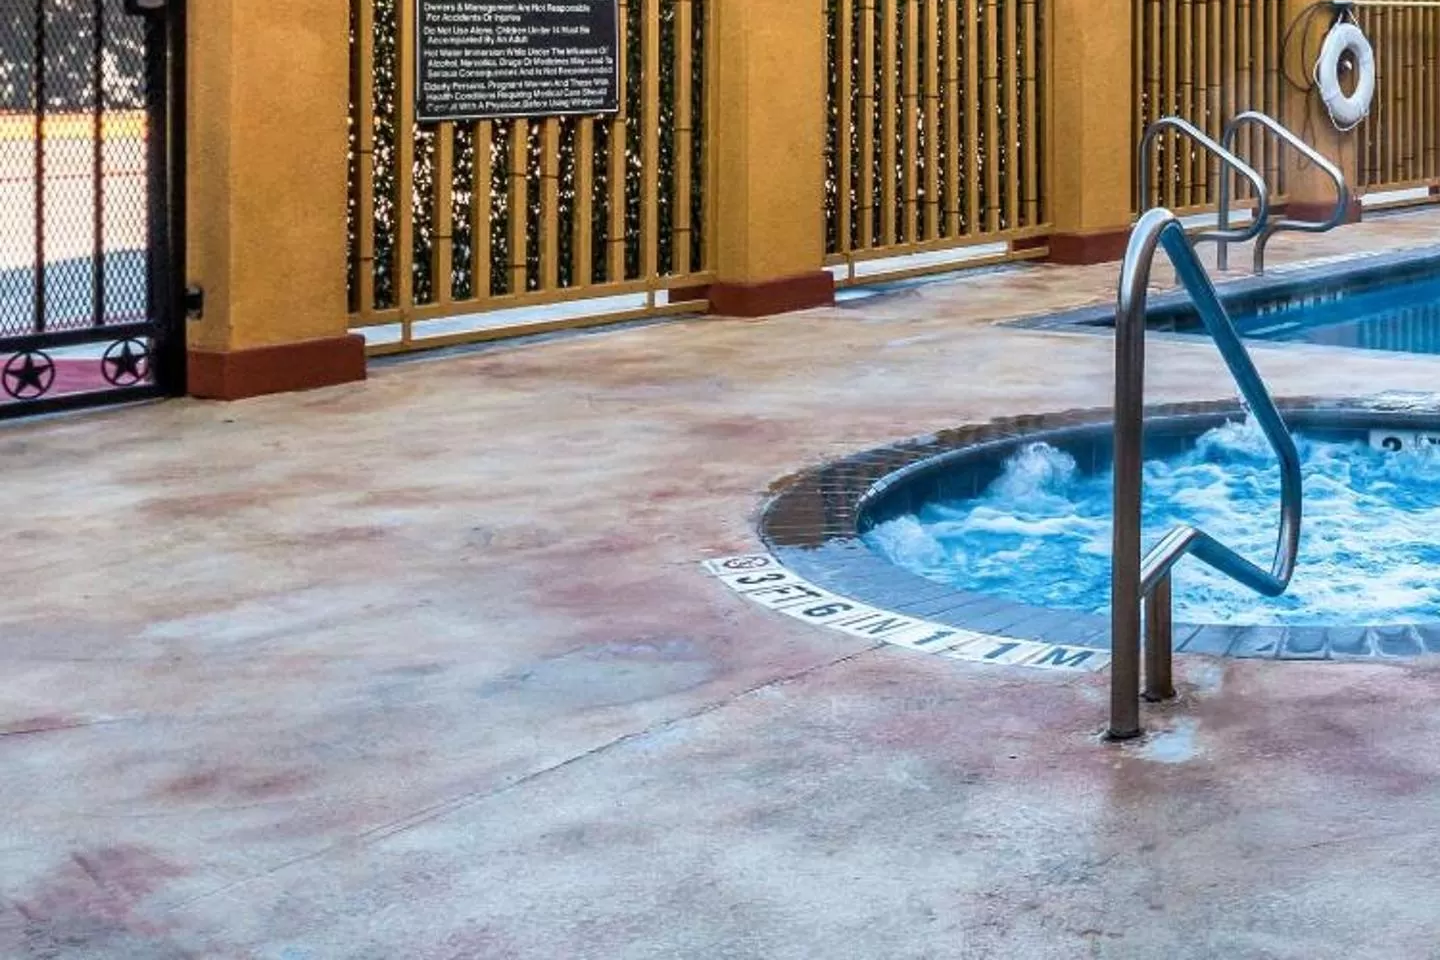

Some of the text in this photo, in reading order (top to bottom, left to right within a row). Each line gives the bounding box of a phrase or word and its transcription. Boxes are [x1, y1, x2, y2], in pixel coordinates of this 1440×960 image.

[457, 3, 463, 11] &
[532, 4, 546, 12] Not
[483, 13, 493, 21] Or
[424, 27, 435, 35] Do
[736, 573, 786, 584] 3
[754, 585, 823, 603] FT
[802, 602, 854, 617] 6
[839, 613, 911, 635] IN
[1035, 647, 1095, 667] M
